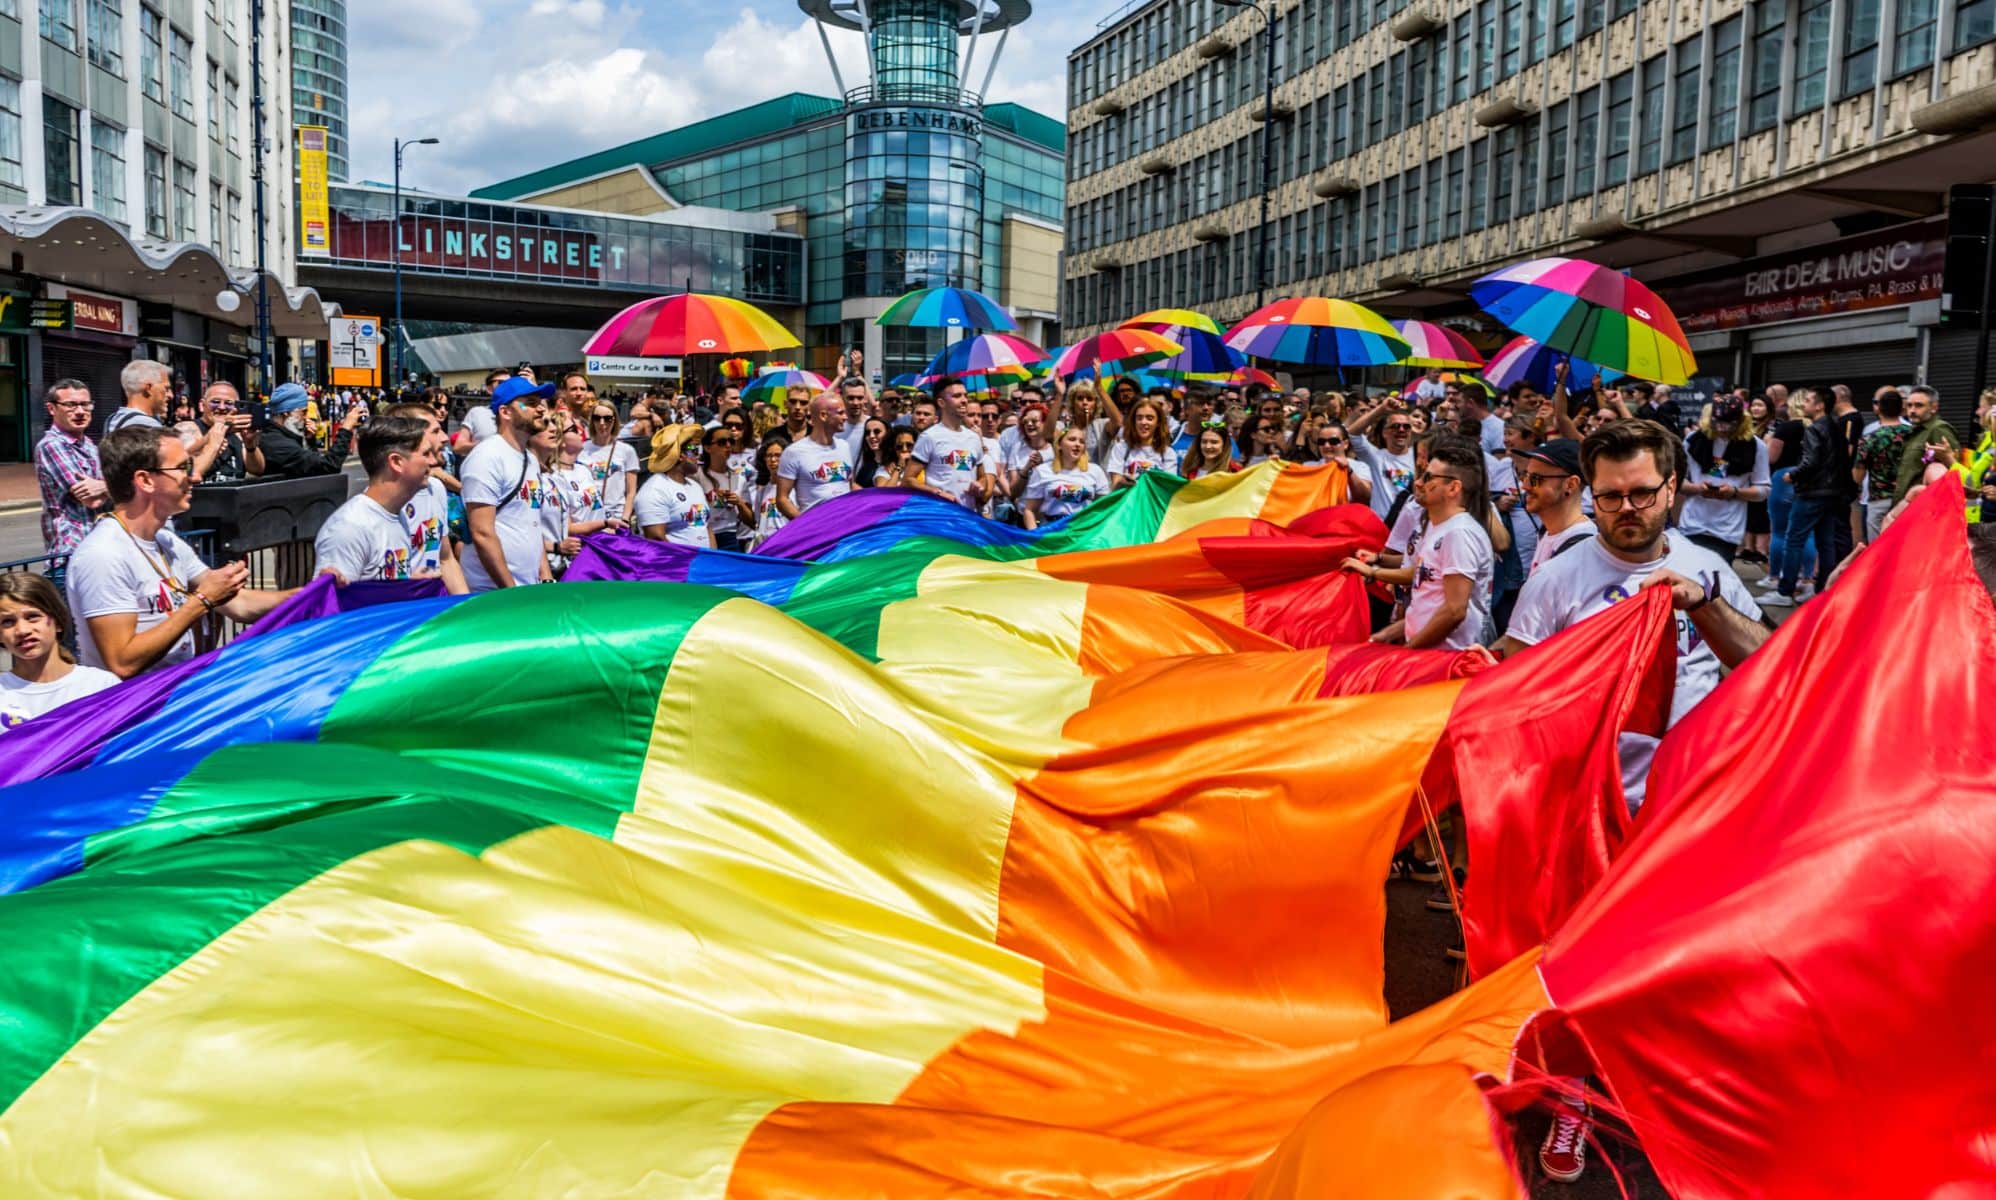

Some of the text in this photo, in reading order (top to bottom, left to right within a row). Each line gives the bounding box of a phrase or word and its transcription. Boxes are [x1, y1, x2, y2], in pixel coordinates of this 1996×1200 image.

[857, 110, 982, 137] DEBENHAMS
[308, 182, 321, 191] TO
[306, 192, 323, 201] LET
[399, 225, 625, 270] LINKSTREET
[1744, 240, 1913, 297] FAIR DEAL MUSIC
[1887, 280, 1916, 295] Brass
[74, 301, 97, 320] ERBAL
[30, 319, 66, 328] SUBWAY
[628, 363, 640, 371] Car
[643, 364, 660, 372] Park
